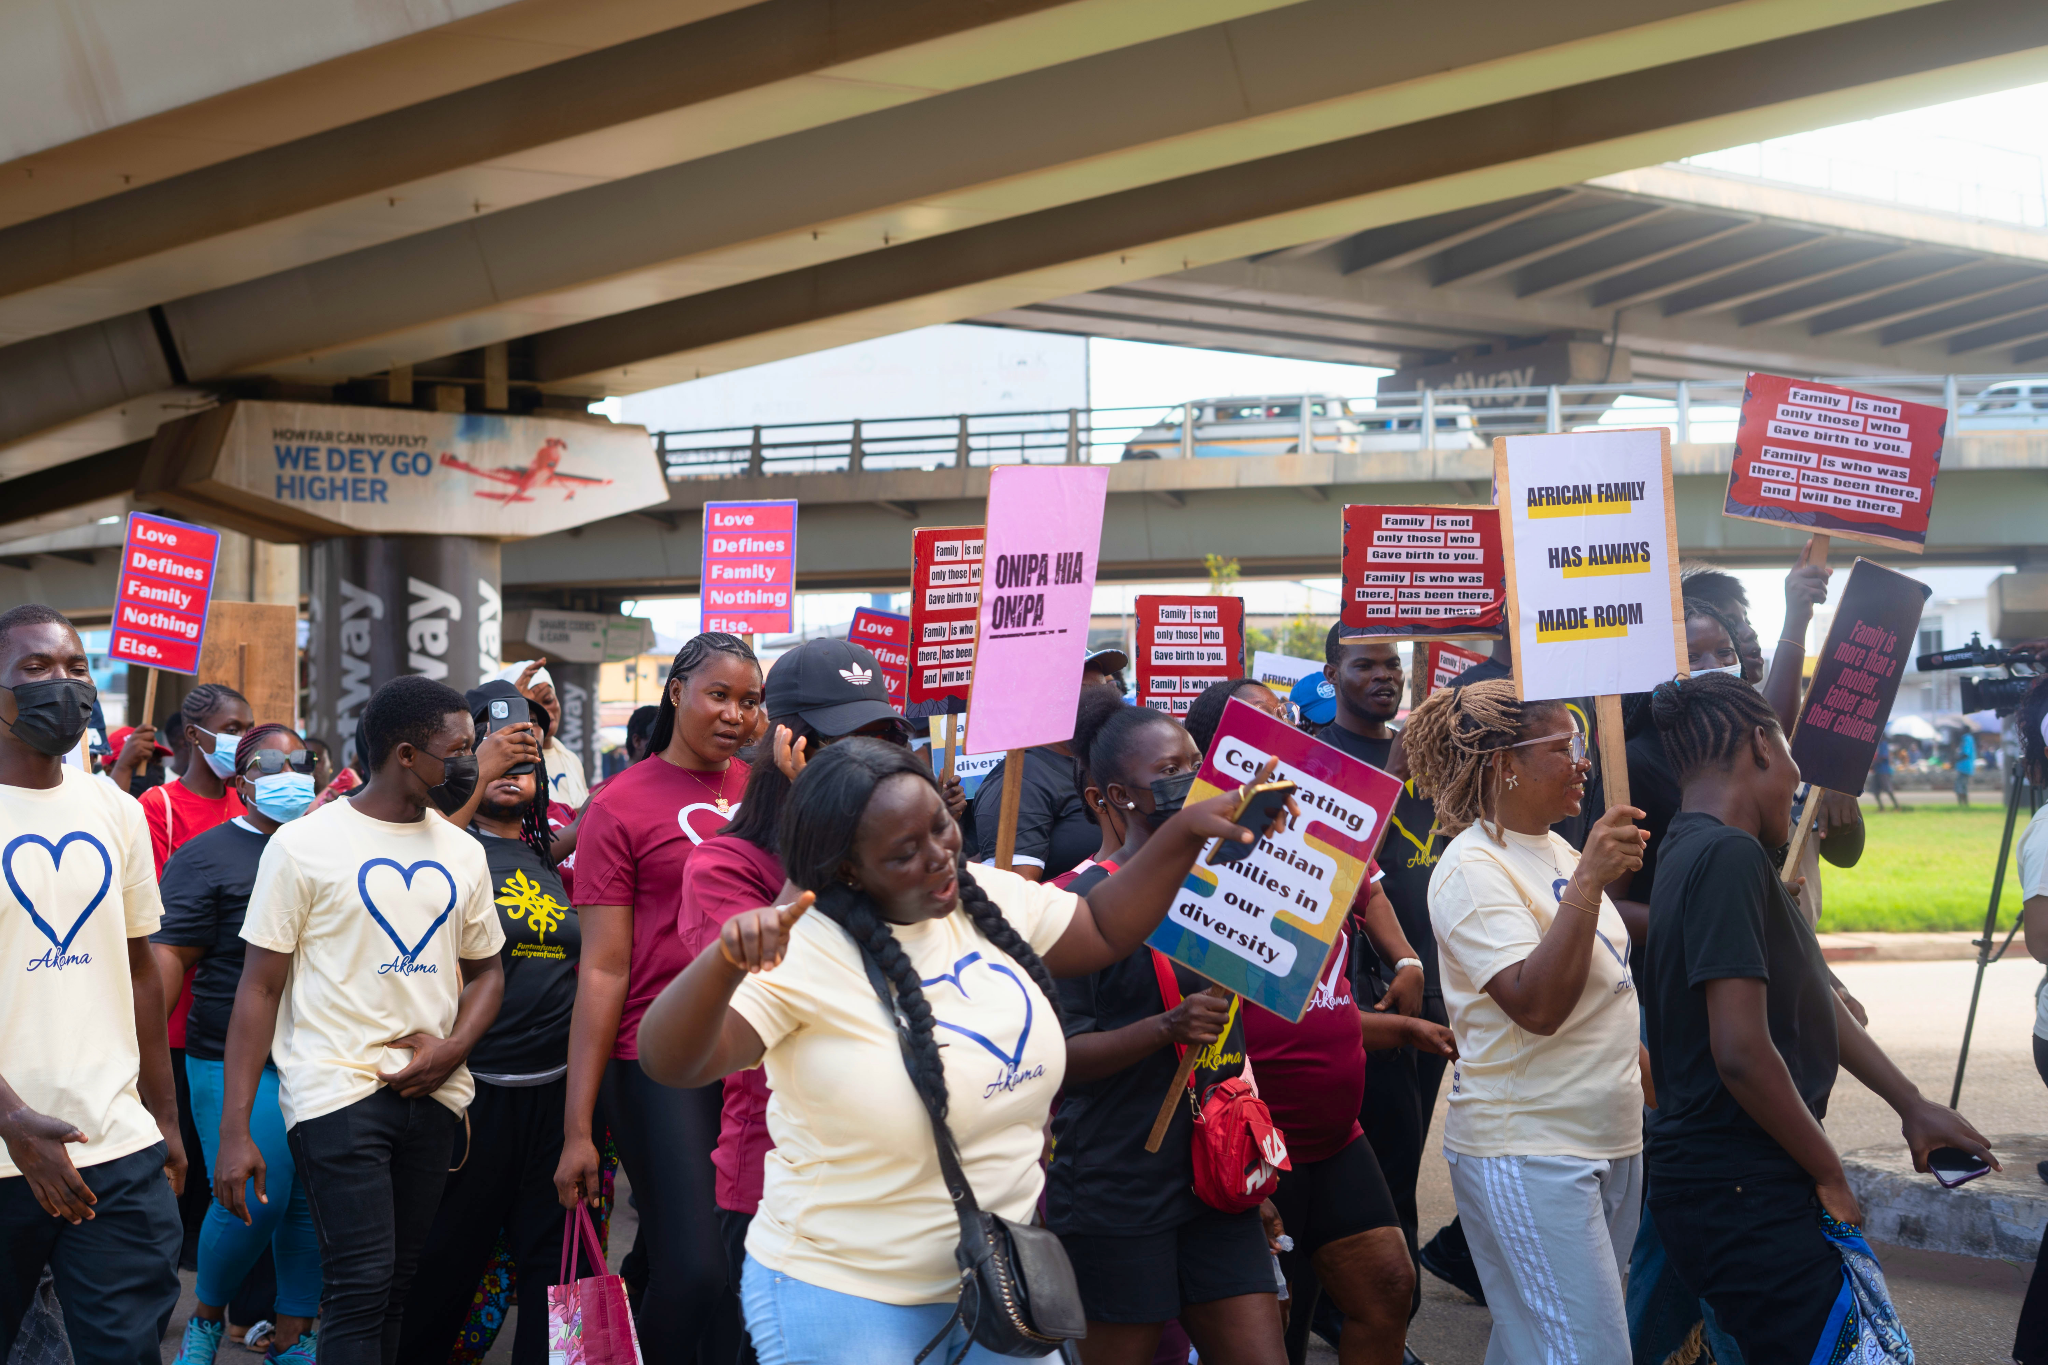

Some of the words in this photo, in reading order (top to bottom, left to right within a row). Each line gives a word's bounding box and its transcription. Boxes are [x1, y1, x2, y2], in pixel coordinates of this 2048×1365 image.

[1792, 391, 1841, 407] Family
[1855, 400, 1868, 410] is
[1873, 403, 1898, 415] not
[1780, 408, 1812, 421] only
[1817, 413, 1860, 428] those
[1870, 421, 1901, 434] who
[273, 428, 306, 442] HOW
[308, 430, 334, 443] FAR
[336, 431, 365, 445] CAN
[368, 433, 396, 446] YOU
[398, 434, 428, 448] FLY?
[1774, 425, 1809, 438] Gave
[1814, 430, 1849, 444] birth
[1854, 437, 1868, 447] to
[1873, 442, 1904, 454] you.
[274, 446, 321, 471] WE
[327, 448, 386, 474] DEY
[391, 451, 432, 476] GO
[1763, 448, 1811, 464] Family
[1822, 457, 1836, 468] is
[1840, 460, 1872, 474] who
[1877, 466, 1907, 479] was
[276, 474, 388, 504] HIGHER
[1801, 472, 1828, 485] has
[1833, 477, 1870, 491] been
[1527, 484, 1592, 507] AFRICAN
[1597, 481, 1645, 503] FAMILY
[1762, 484, 1790, 496] and
[1802, 490, 1829, 503] will
[1833, 495, 1852, 506] be
[1856, 498, 1900, 515] there.
[714, 513, 754, 526] Love
[1385, 518, 1425, 527] Family
[1436, 518, 1447, 526] is
[1451, 518, 1470, 527] not
[136, 525, 177, 546] Love
[713, 538, 785, 553] Defines
[1377, 534, 1403, 543] only
[1407, 534, 1441, 543] those
[1450, 535, 1474, 543] who
[936, 546, 958, 558] Family
[965, 544, 970, 555] is
[1372, 550, 1401, 559] Gave
[1406, 551, 1434, 560] birth
[1438, 552, 1449, 560] to
[1454, 552, 1478, 561] you.
[1548, 546, 1582, 568] HAS
[1588, 541, 1650, 566] ALWAYS
[132, 552, 204, 580] Defines
[712, 564, 776, 582] Family
[931, 570, 946, 581] only
[948, 568, 967, 580] those
[972, 568, 981, 578] wh
[995, 553, 1048, 589] ONIPA
[1055, 552, 1083, 585] HIA
[1366, 574, 1405, 583] Family
[1414, 574, 1425, 582] is
[1430, 574, 1454, 583] who
[1458, 575, 1482, 583] was
[127, 580, 191, 610] Family
[710, 589, 787, 607] Nothing
[929, 594, 945, 605] Gave
[947, 592, 963, 603] birth
[965, 592, 972, 602] to
[1357, 590, 1393, 599] there,
[1399, 590, 1420, 599] has
[1424, 591, 1454, 599] been
[1458, 591, 1492, 600] there,
[992, 594, 1044, 630] ONIPA
[1161, 609, 1186, 620] Family
[1194, 609, 1200, 619] is
[1203, 610, 1216, 619] not
[1368, 606, 1390, 614] and
[1400, 606, 1421, 615] will
[1425, 607, 1440, 615] be
[1444, 607, 1481, 616] there.
[1538, 607, 1588, 632] MADE
[1594, 603, 1643, 628] ROOM
[123, 607, 198, 638] Nothing
[709, 619, 753, 632] Else.
[858, 619, 893, 636] Love
[924, 626, 946, 638] Family
[951, 625, 957, 635] is
[959, 624, 973, 634] who
[1157, 630, 1173, 640] only
[1176, 630, 1198, 639] those
[1203, 630, 1220, 639] who
[1849, 620, 1888, 652] Family
[1883, 630, 1897, 653] is
[118, 637, 162, 659] Else.
[857, 644, 908, 666] fine
[919, 650, 939, 662] there,
[942, 649, 954, 659] has
[956, 648, 972, 658] been
[1154, 651, 1173, 660] Gave
[1176, 651, 1194, 660] birth
[1197, 651, 1204, 660] to
[1207, 652, 1223, 661] you.
[1944, 652, 1974, 662] REUTERS
[1440, 654, 1456, 668] Family
[1833, 642, 1866, 667] more
[1863, 649, 1889, 677] than
[1886, 660, 1897, 677] a
[924, 673, 937, 684] and
[942, 671, 954, 682] will
[956, 671, 964, 681] be
[1151, 680, 1176, 690] Family
[1183, 679, 1189, 689] is
[1192, 680, 1208, 689] who
[1436, 674, 1447, 685] only
[1837, 667, 1879, 699] mother,
[1147, 700, 1170, 710] there,
[1173, 700, 1187, 710] has
[1823, 684, 1860, 713] father
[1856, 698, 1880, 719] and
[1806, 703, 1837, 730] their
[1833, 714, 1877, 743] children.
[956, 756, 1006, 772] divers
[1258, 838, 1324, 880] naian
[1203, 840, 1290, 898] milies
[1295, 889, 1318, 913] in
[1224, 891, 1265, 919] our
[1179, 902, 1280, 964] diversity
[26, 946, 92, 971] Akoma
[378, 955, 438, 976] Akoma
[1307, 989, 1350, 1011] Akoma
[1194, 1045, 1242, 1071] Akoma
[983, 1062, 1046, 1099] Akoma
